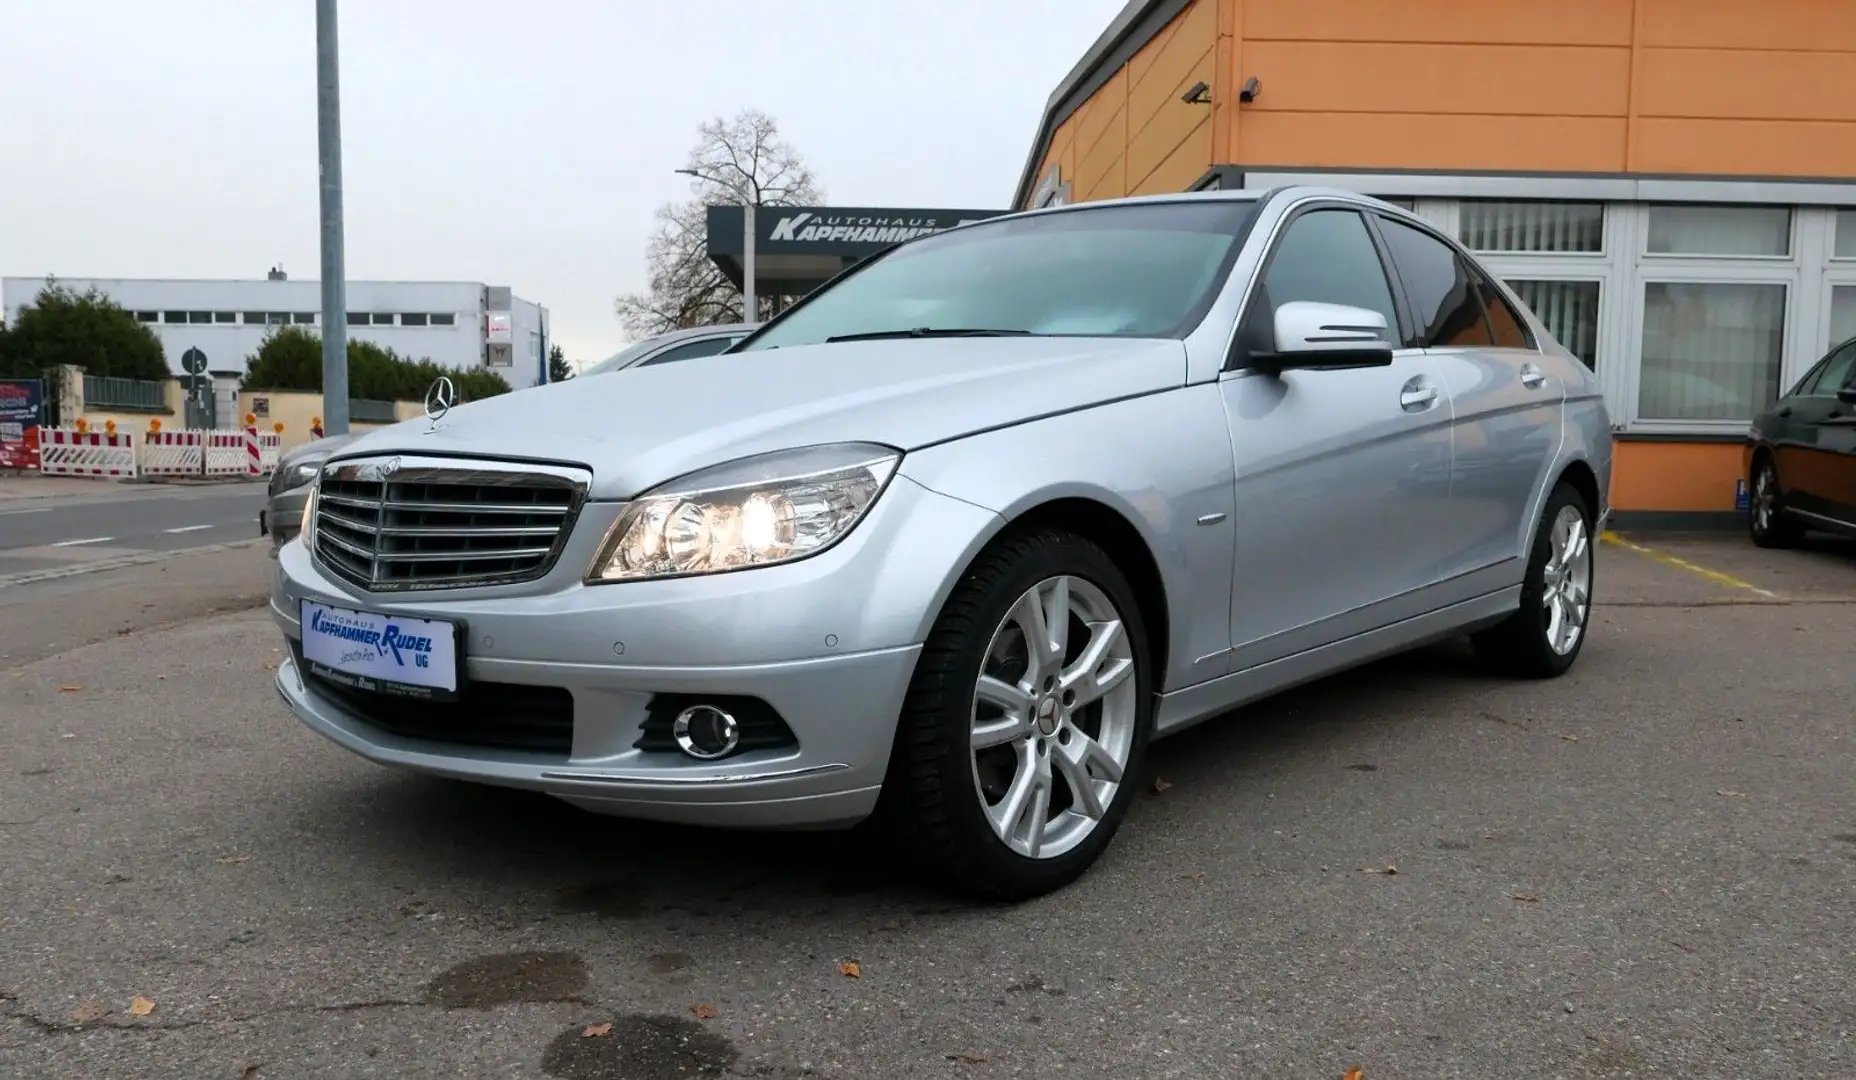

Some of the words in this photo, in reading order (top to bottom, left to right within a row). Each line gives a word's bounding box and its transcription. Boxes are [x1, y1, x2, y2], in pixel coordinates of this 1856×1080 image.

[768, 212, 949, 242] KAPFHAMM
[810, 216, 937, 228] AUTOHAUS
[322, 612, 375, 629] AUTOHAUS
[311, 609, 384, 657] KAPFHAMMER
[381, 624, 433, 666] RUDEL
[415, 653, 429, 668] UG
